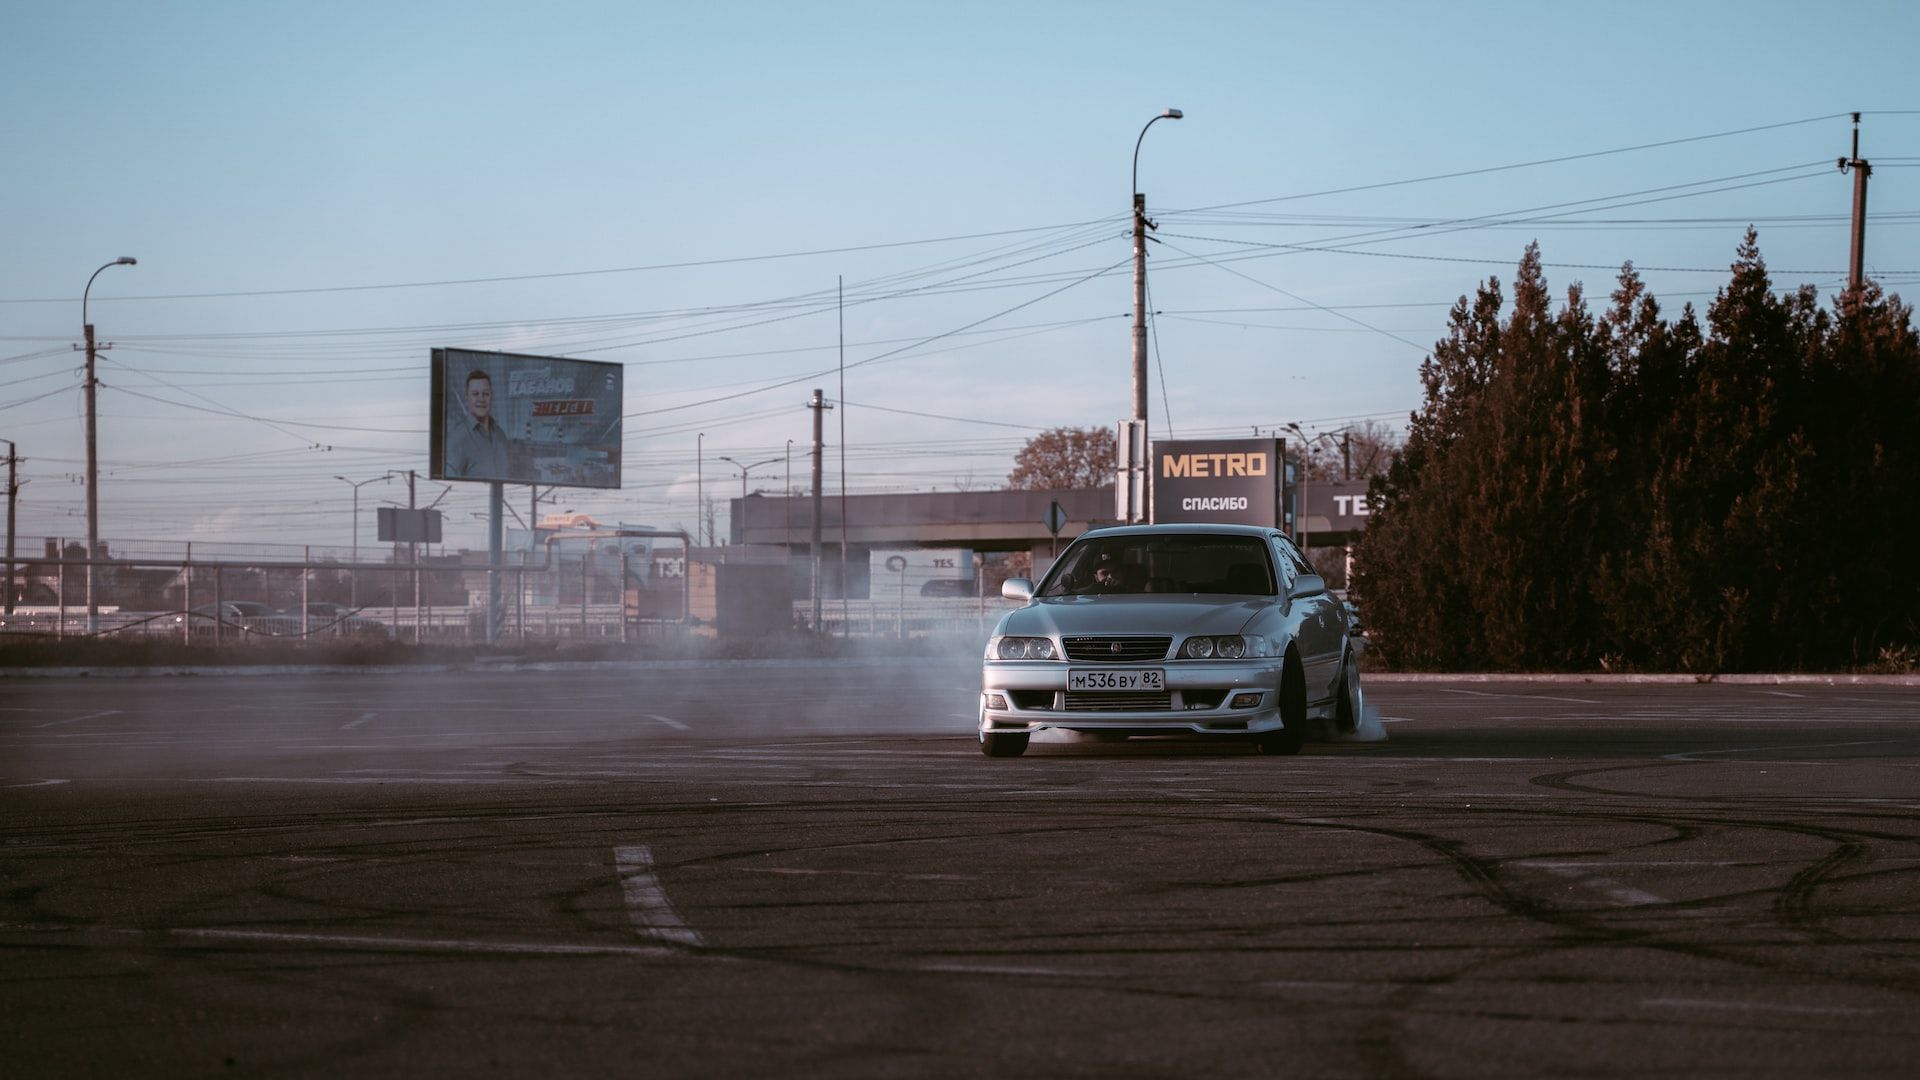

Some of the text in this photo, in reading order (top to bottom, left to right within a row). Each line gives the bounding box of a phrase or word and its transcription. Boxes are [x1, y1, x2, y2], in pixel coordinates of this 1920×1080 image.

[1163, 453, 1266, 477] METRO
[1182, 497, 1247, 511] СПАСИБО
[1143, 672, 1158, 683] 82
